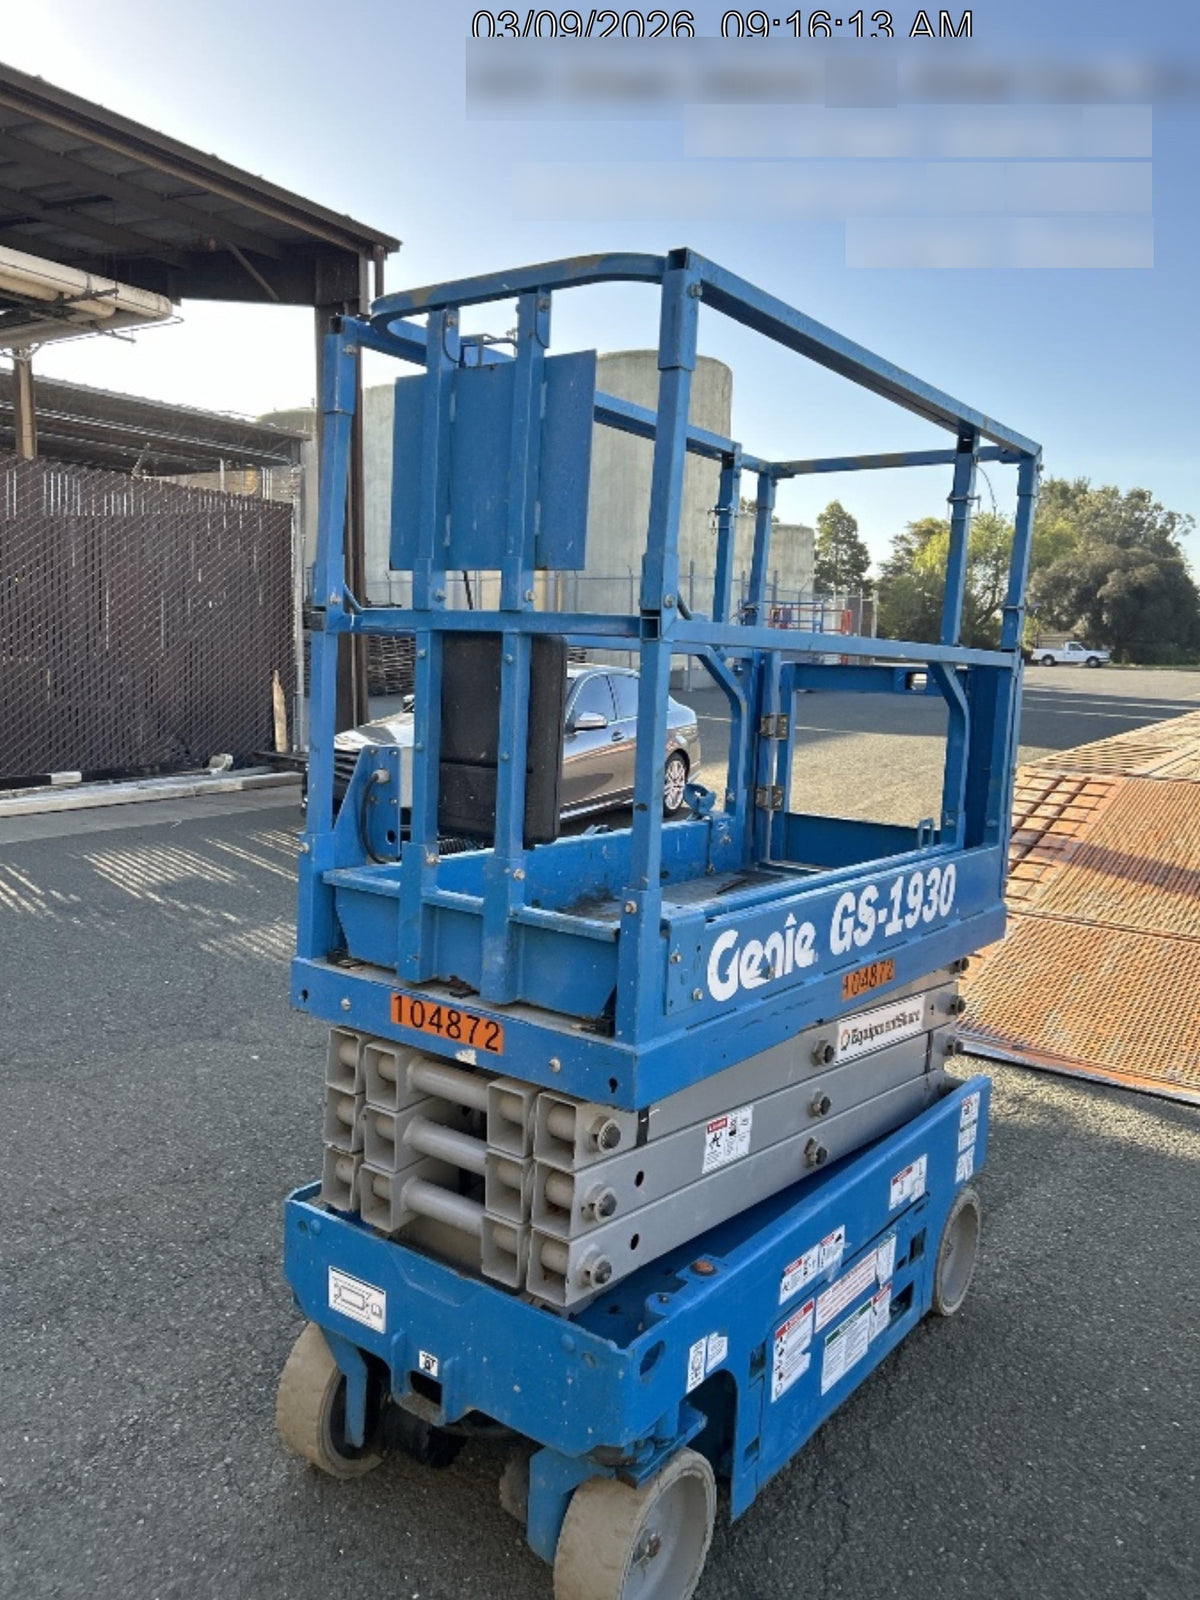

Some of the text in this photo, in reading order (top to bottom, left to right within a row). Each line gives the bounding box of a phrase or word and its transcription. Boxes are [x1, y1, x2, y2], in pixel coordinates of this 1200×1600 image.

[707, 863, 957, 1002] Genie GS-1930
[842, 958, 894, 996] 104872
[393, 994, 501, 1052] 104872
